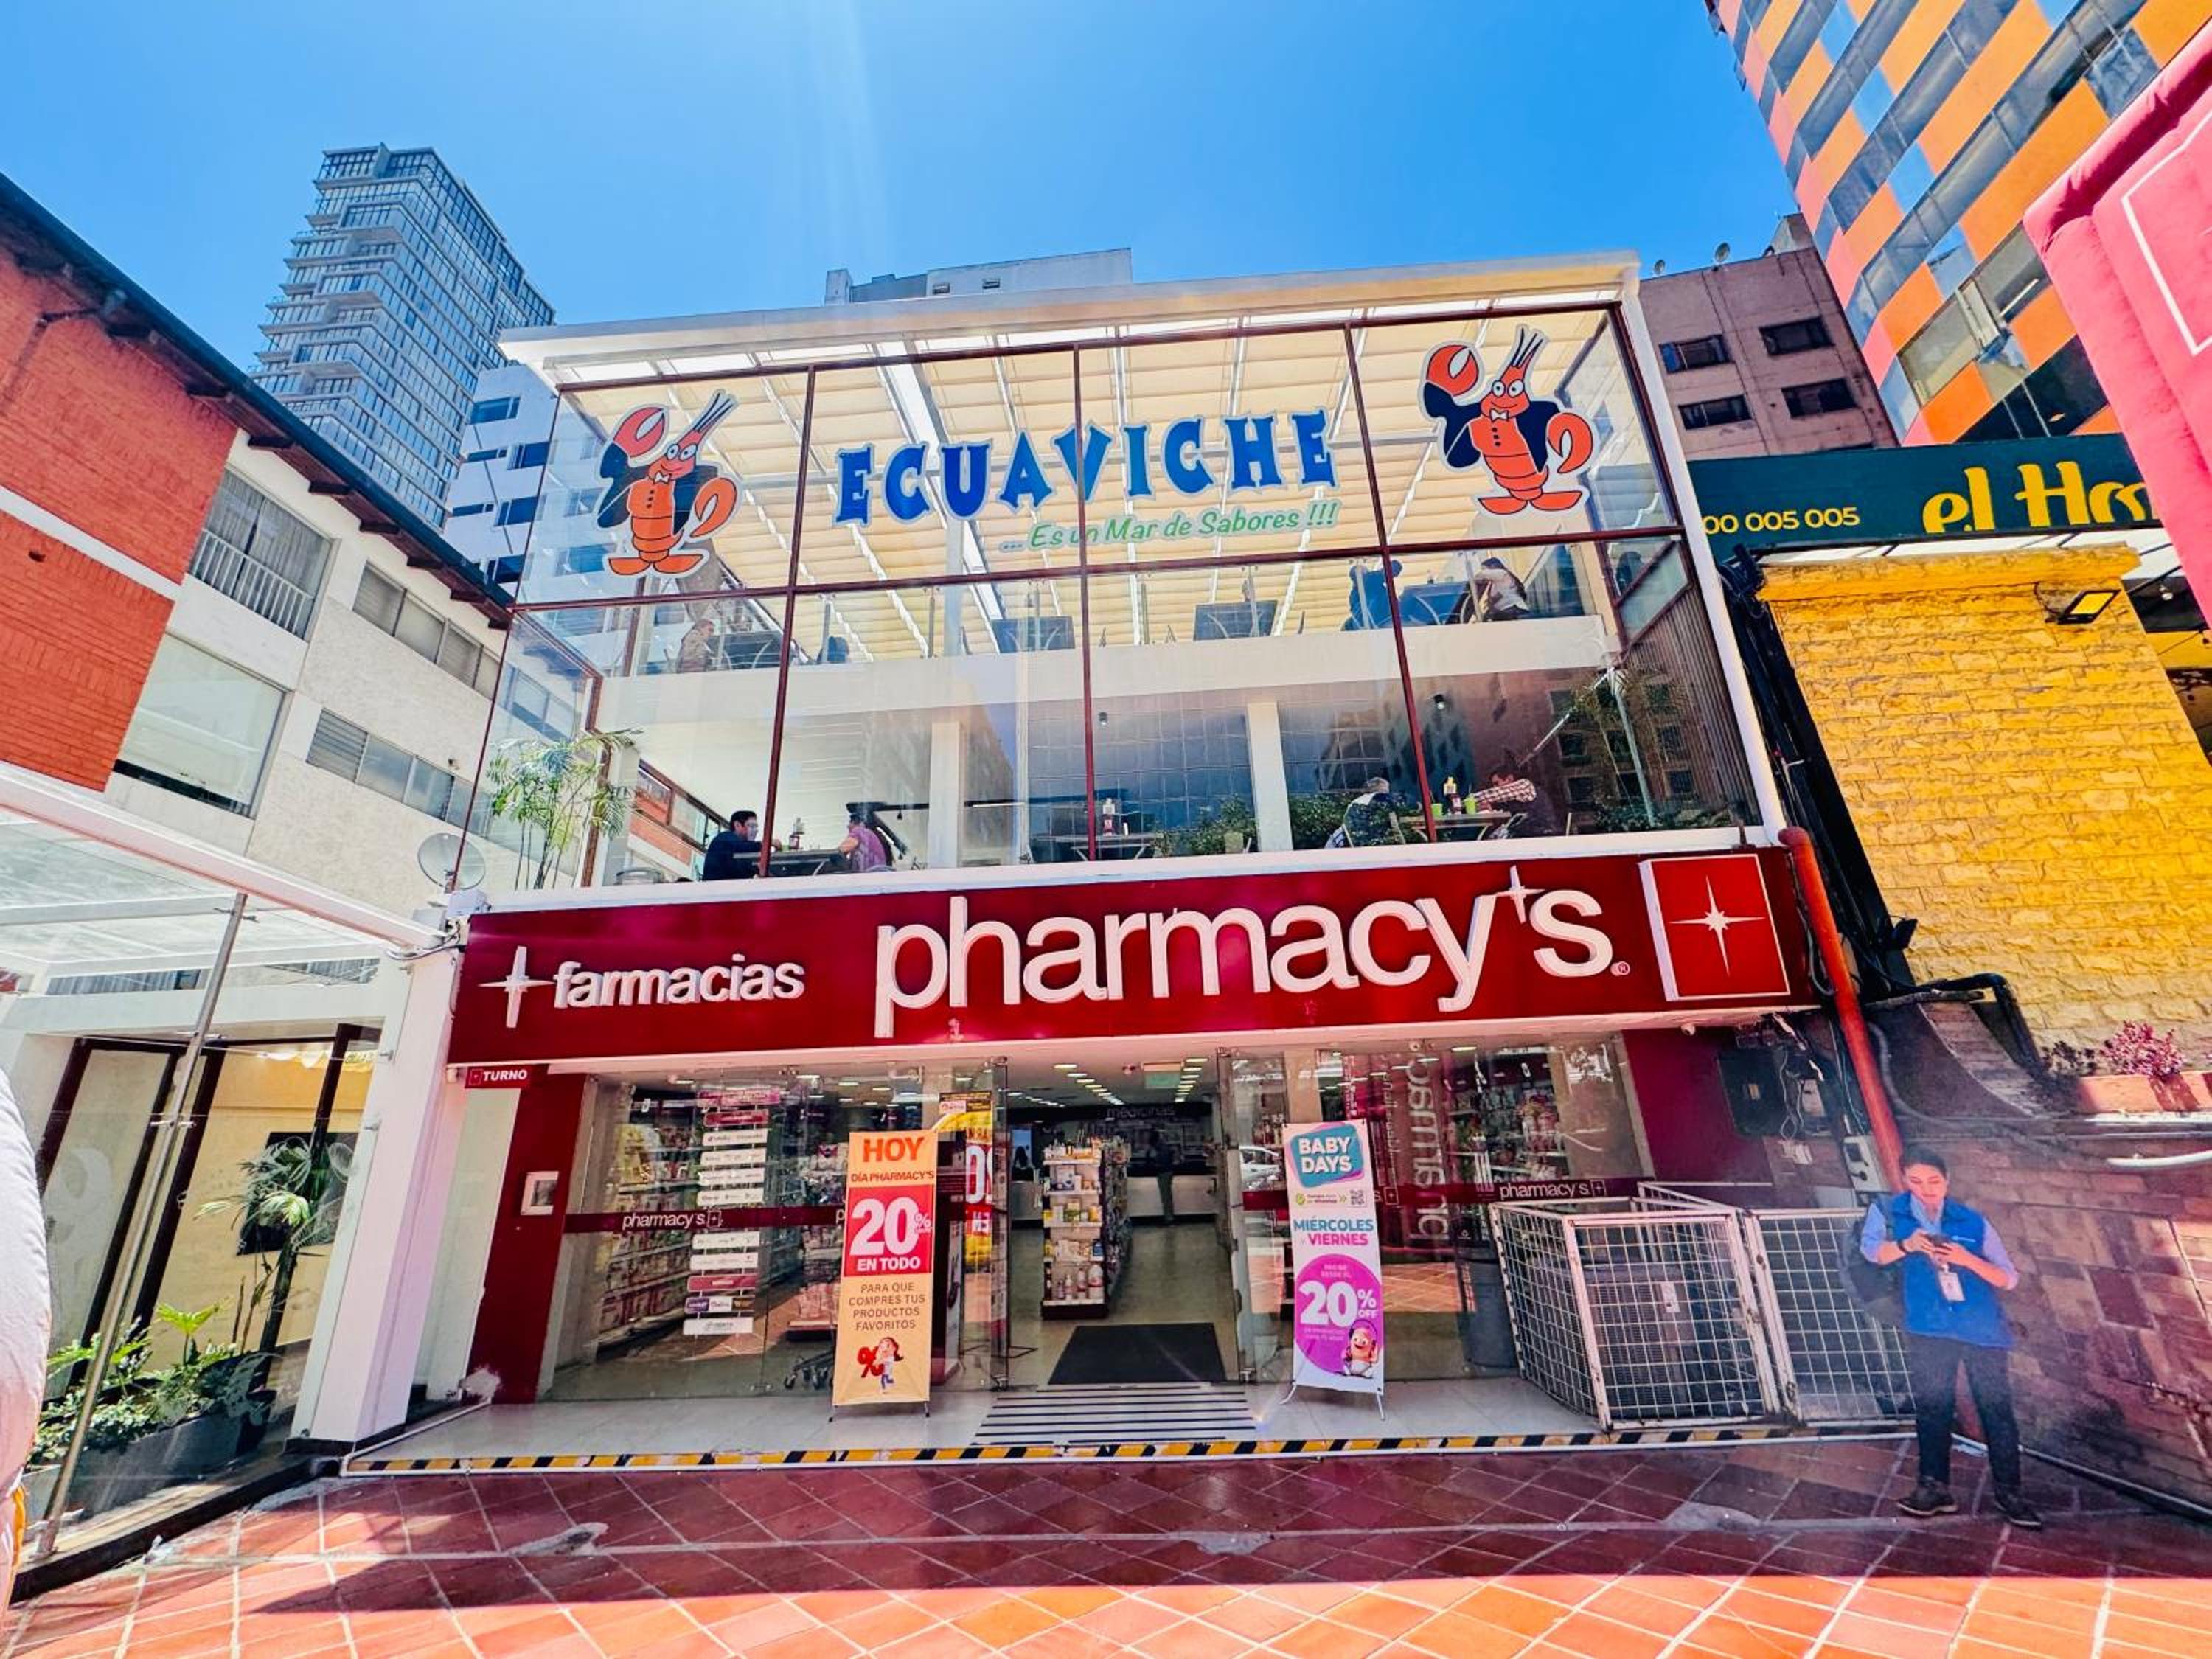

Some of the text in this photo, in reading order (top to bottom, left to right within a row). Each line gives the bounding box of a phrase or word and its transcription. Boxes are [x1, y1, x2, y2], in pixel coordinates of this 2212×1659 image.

[835, 408, 1337, 526] ECUAVICHE
[1922, 467, 1994, 533] el
[1745, 510, 1801, 532] 005
[1804, 506, 1860, 529] 005
[1030, 524, 1063, 548] Es
[1105, 518, 1158, 540] Mar
[1164, 514, 1192, 537] de
[1198, 510, 1300, 535] Sabores
[874, 866, 1615, 1038] pharmacy's
[553, 953, 805, 1009] farmacias
[481, 1069, 528, 1082] TURNO
[862, 1136, 925, 1163] HOY
[1298, 1136, 1351, 1155] BABY
[1301, 1155, 1353, 1174] DAYS
[869, 1169, 935, 1182] PHARMACY'S
[1499, 1181, 1590, 1201] pharmacy's
[622, 1211, 706, 1231] pharmacy's
[1293, 1215, 1374, 1232] MIÉRCOLES
[1307, 1232, 1370, 1246] VIERNES
[857, 1256, 921, 1272] EN TODO
[860, 1282, 915, 1294] PARA QUE
[849, 1294, 926, 1307] COMPRES TUS
[852, 1306, 920, 1319] PRODUCTOS
[855, 1319, 917, 1332] FAVORITOS
